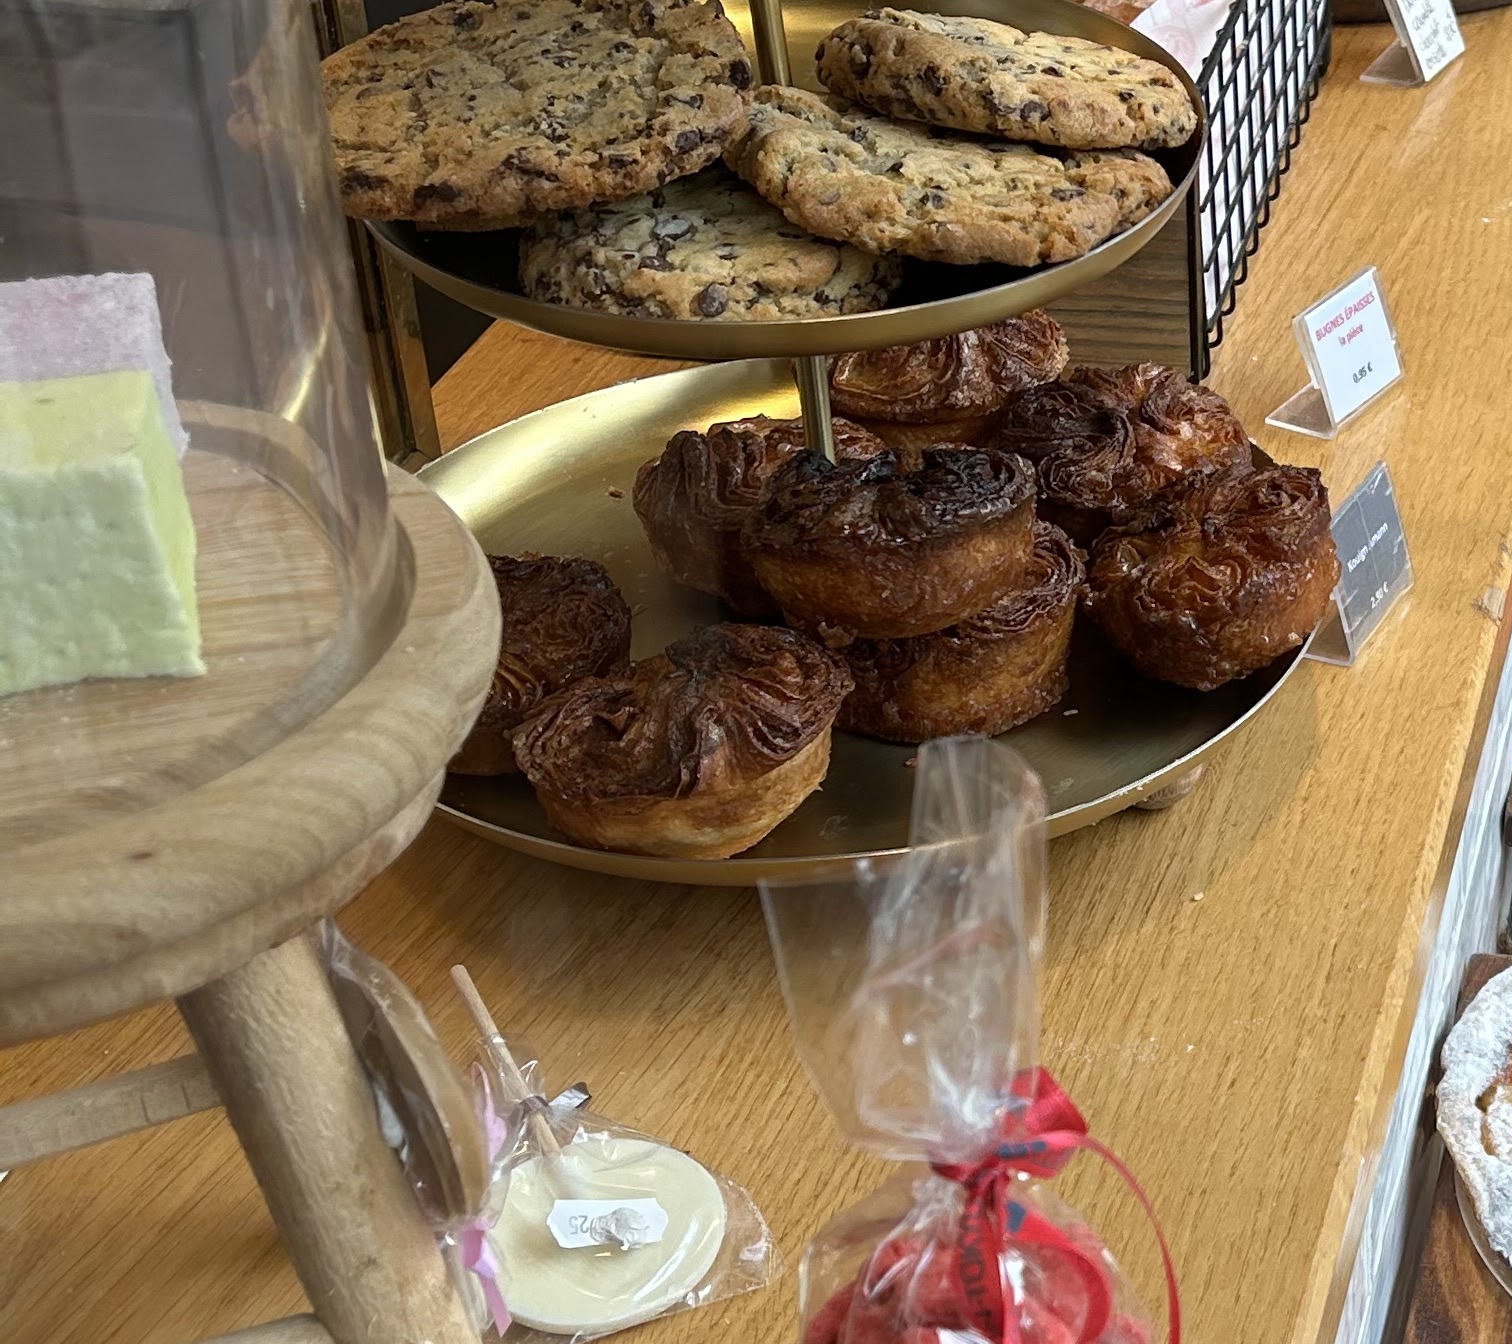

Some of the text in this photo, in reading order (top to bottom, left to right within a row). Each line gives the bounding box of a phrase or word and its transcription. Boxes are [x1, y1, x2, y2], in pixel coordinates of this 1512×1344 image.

[1315, 290, 1375, 342] BUGNES ÉPAISSES
[1347, 545, 1368, 573] Kouign
